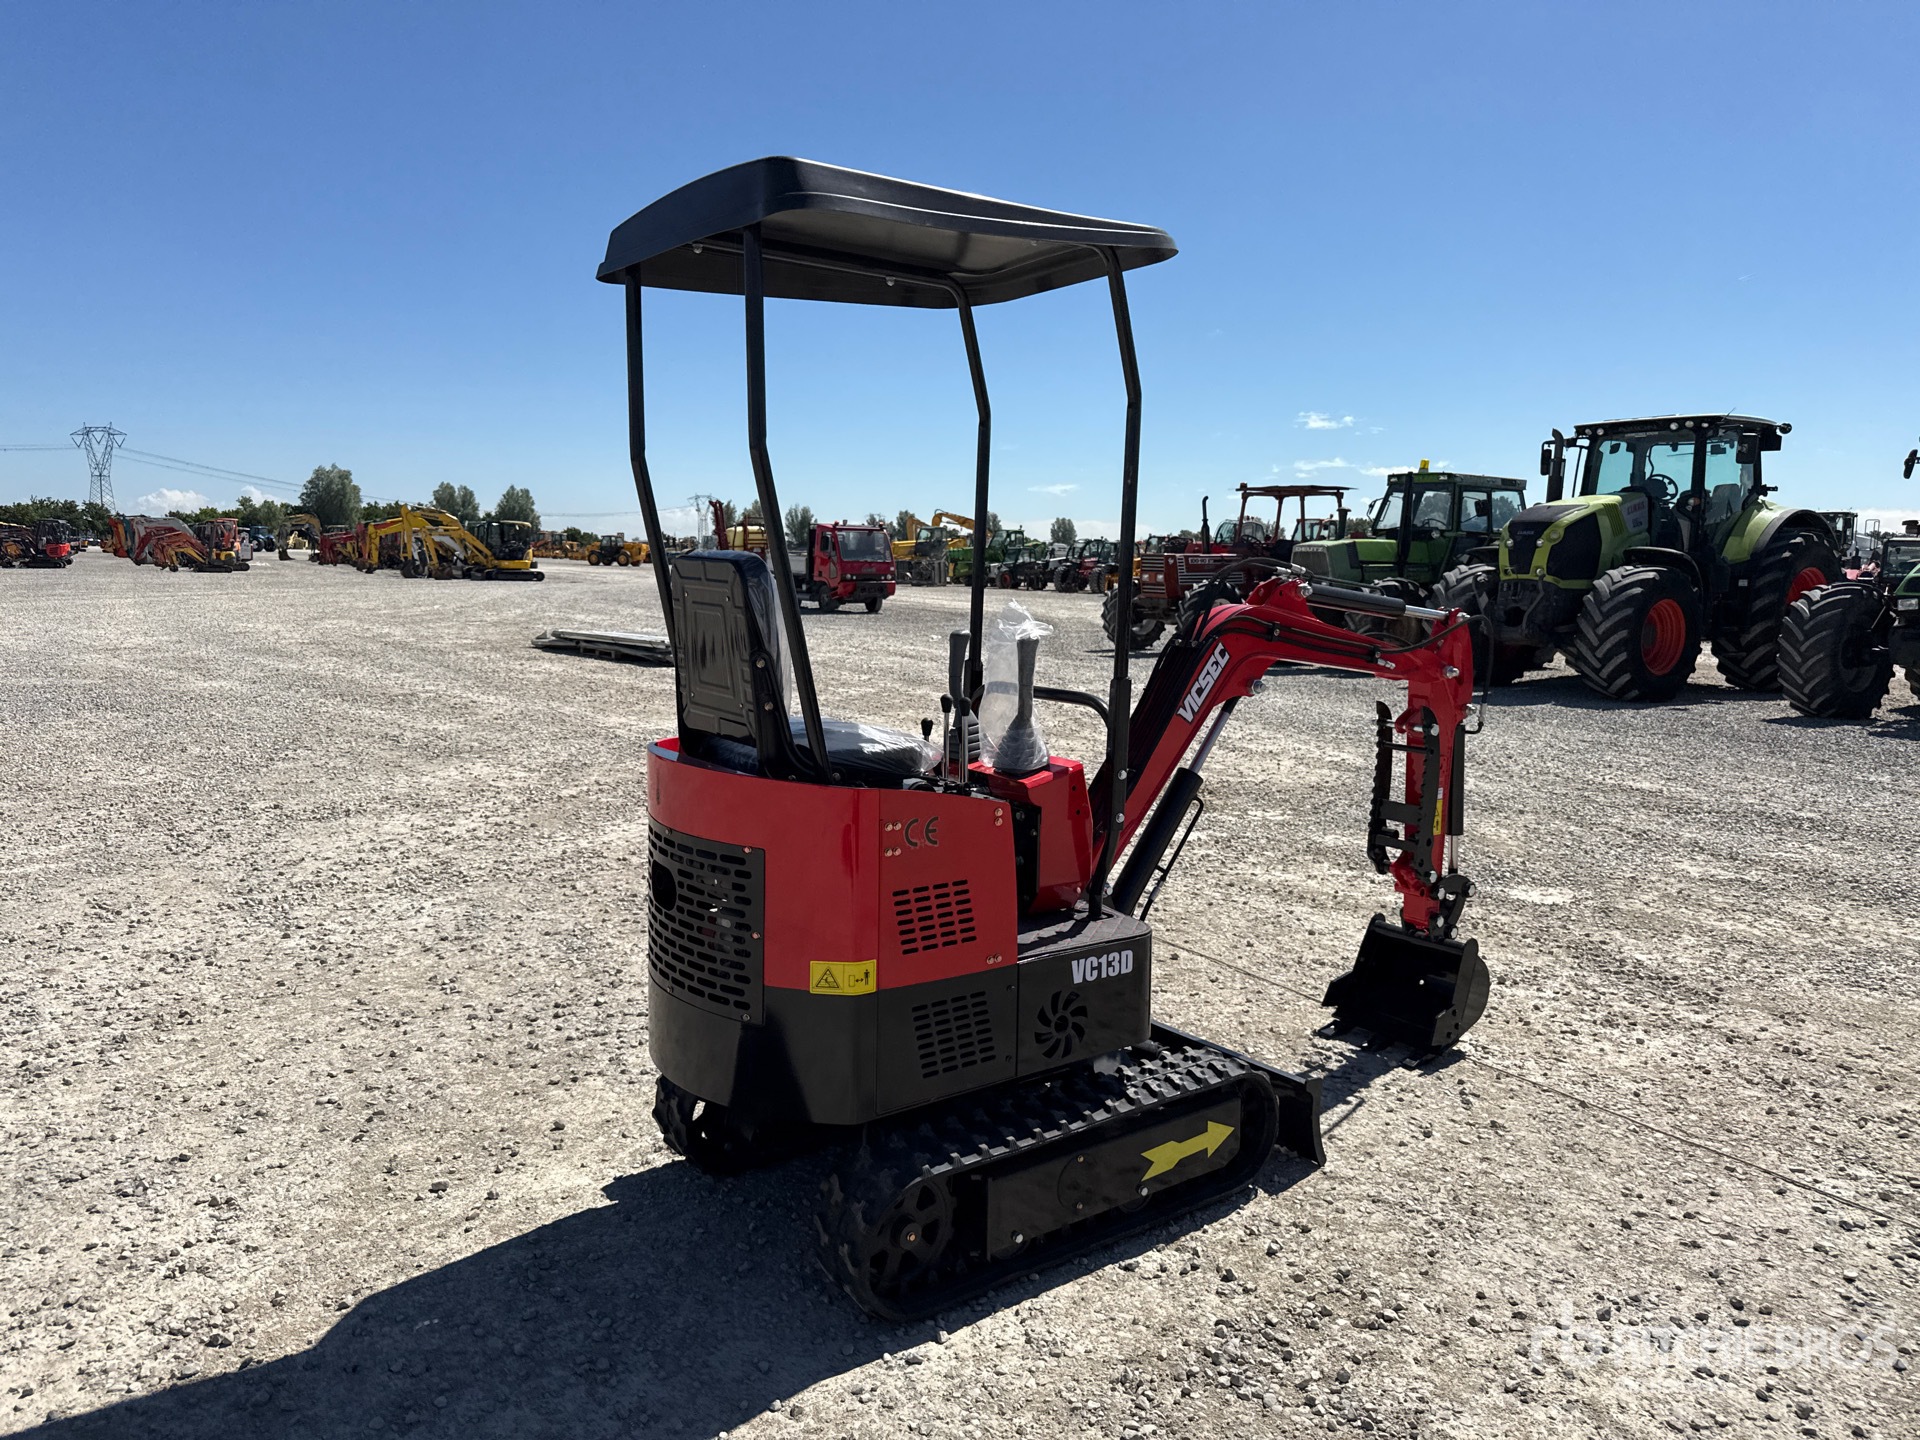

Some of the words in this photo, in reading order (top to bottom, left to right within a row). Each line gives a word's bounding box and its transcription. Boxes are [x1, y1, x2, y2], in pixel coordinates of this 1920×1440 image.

[1176, 641, 1230, 723] VICSEC
[904, 816, 939, 847] CE
[1071, 949, 1133, 985] VC13D
